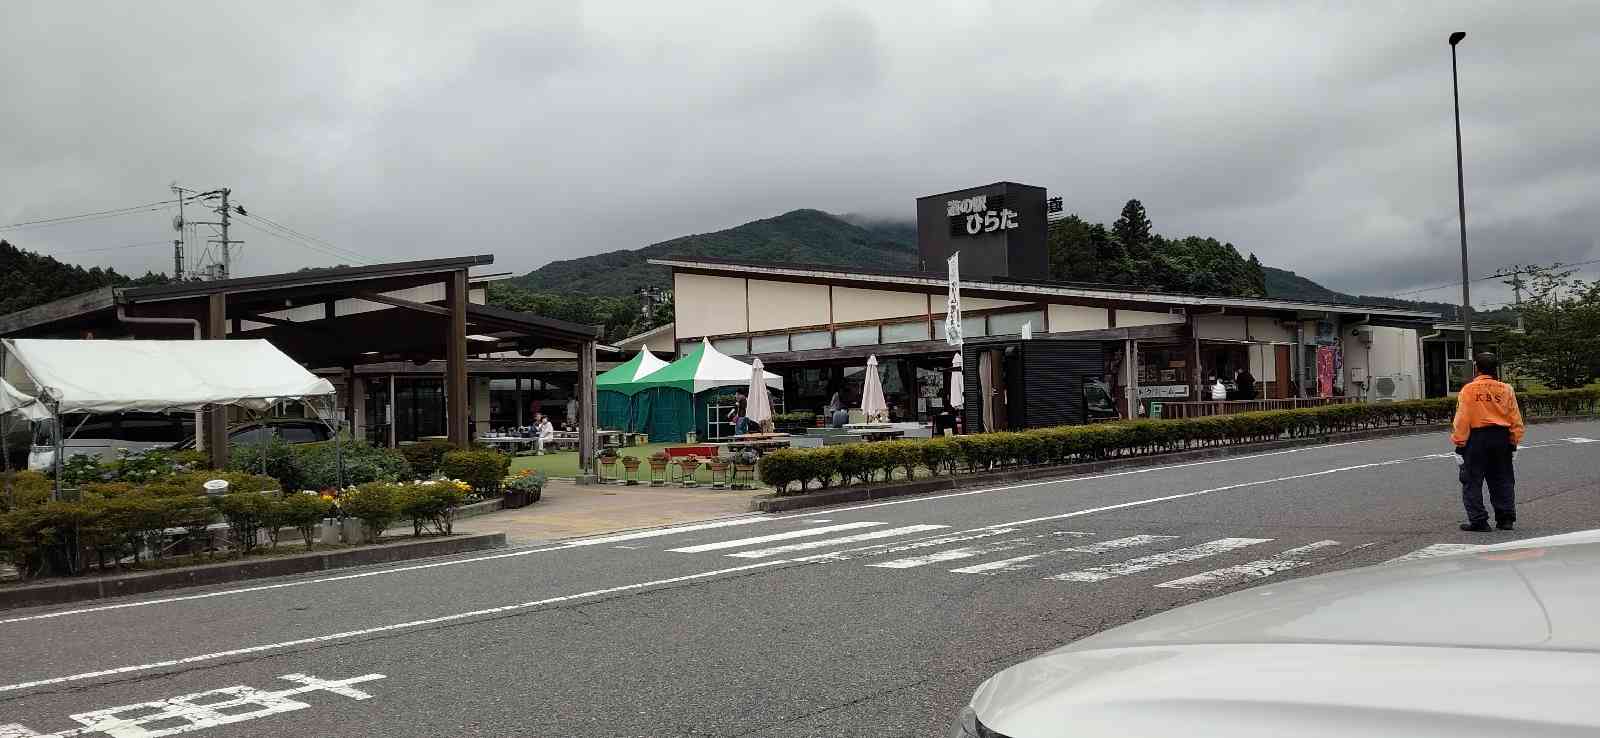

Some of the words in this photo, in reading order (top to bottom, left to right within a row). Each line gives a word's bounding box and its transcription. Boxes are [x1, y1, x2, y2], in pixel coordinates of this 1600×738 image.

[947, 195, 987, 217] 道の駅
[966, 209, 1018, 234] ひらた
[1475, 393, 1502, 404] KBS
